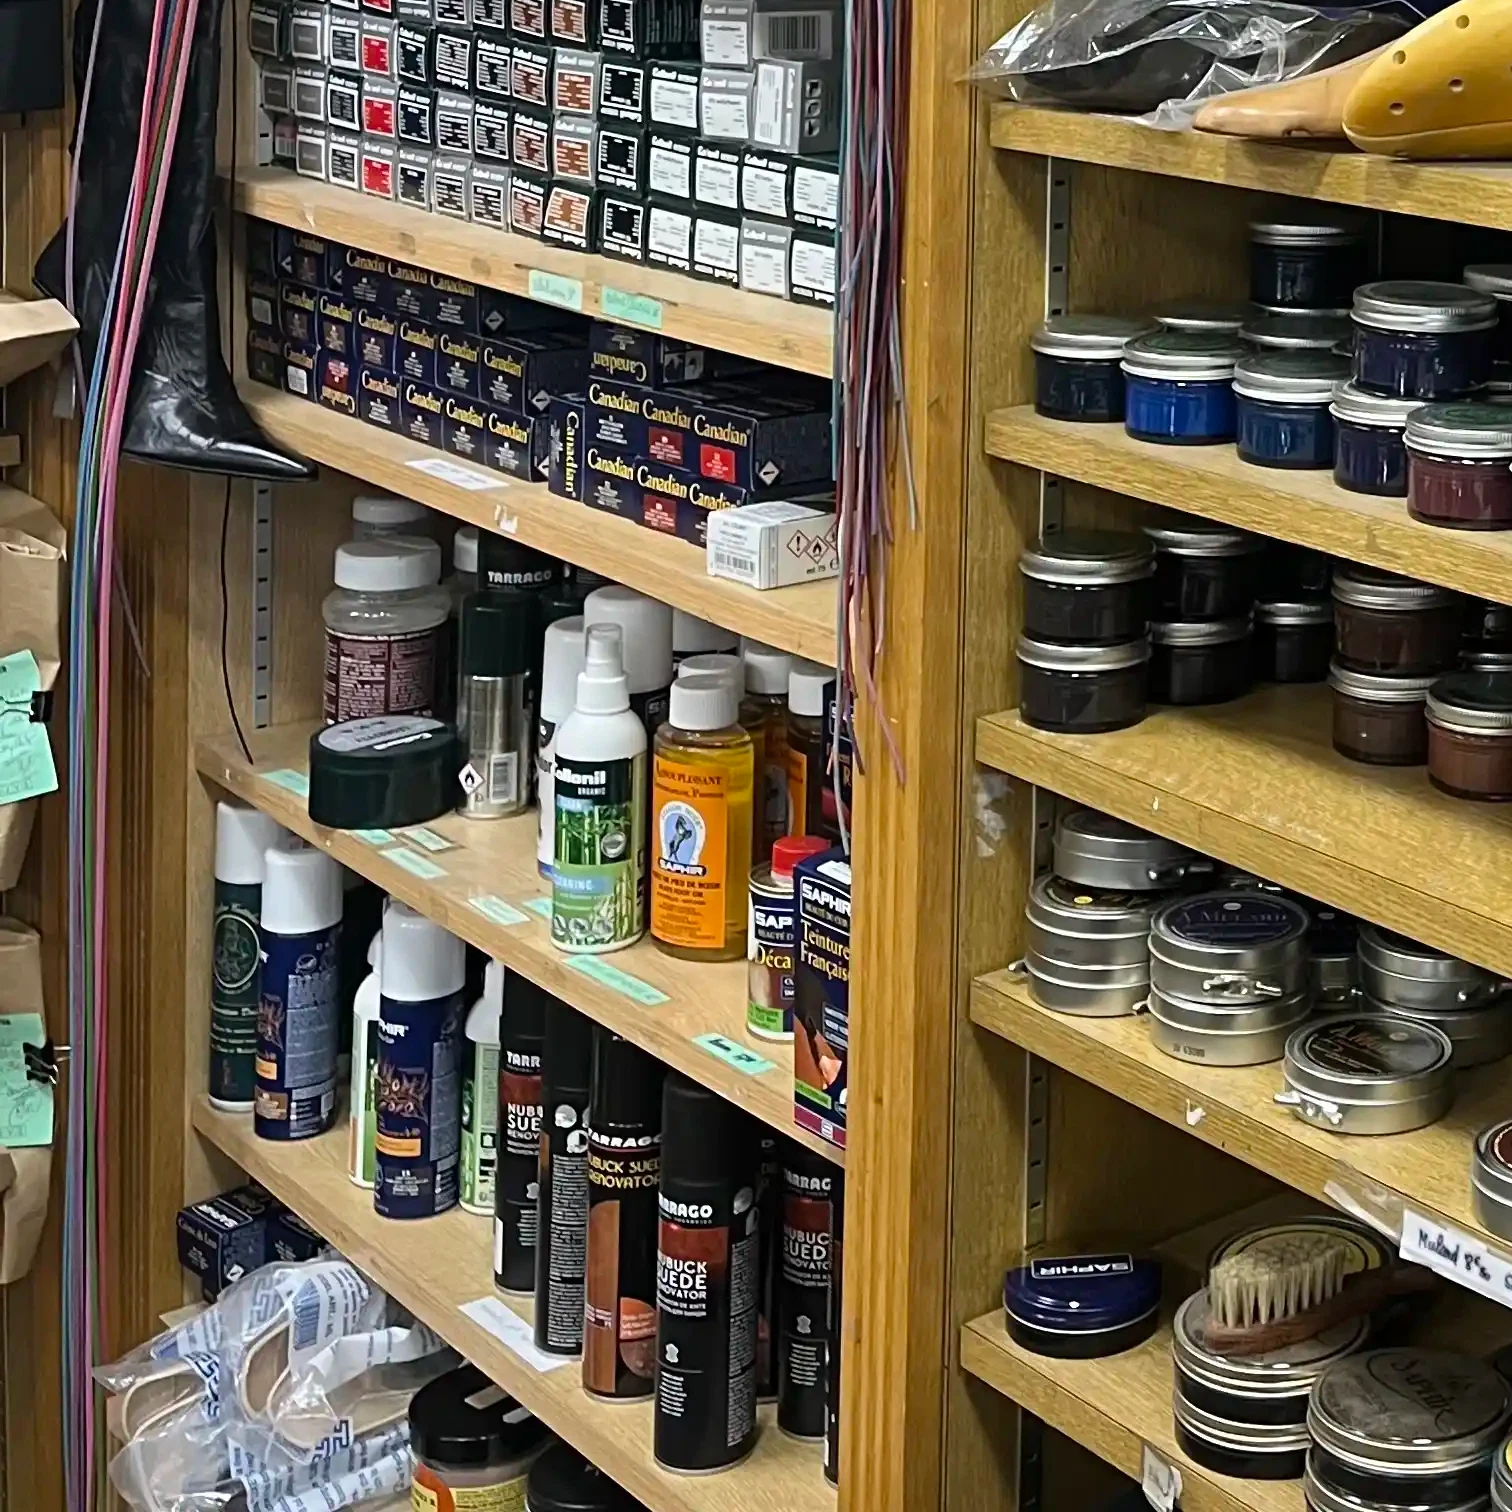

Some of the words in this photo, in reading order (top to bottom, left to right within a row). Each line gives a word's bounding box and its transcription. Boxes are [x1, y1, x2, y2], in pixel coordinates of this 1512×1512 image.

[591, 352, 647, 383] Canadian
[589, 383, 640, 415] Canadian
[642, 398, 692, 430] Canadian
[694, 415, 750, 448] Canadian
[565, 411, 580, 494] Canadian
[587, 448, 634, 481] Canadian
[637, 466, 687, 499] Canadian
[488, 569, 552, 585] TARRAGO
[802, 882, 851, 917] SAPHIR
[755, 911, 793, 929] SAP
[801, 919, 850, 960] Teinture
[754, 944, 792, 969] Déca
[507, 1050, 541, 1067] TARR
[508, 1102, 543, 1118] NUB
[507, 1114, 541, 1131] SUE
[507, 1129, 540, 1140] RENOV
[588, 1152, 624, 1174] UBUCK
[784, 1168, 832, 1191] ARRAG
[658, 1192, 713, 1218] ARRAGO
[784, 1224, 829, 1245] UBUC
[784, 1236, 827, 1260] SUED
[1040, 1262, 1128, 1276] SAPHIR
[657, 1281, 707, 1300] NOVATOR
